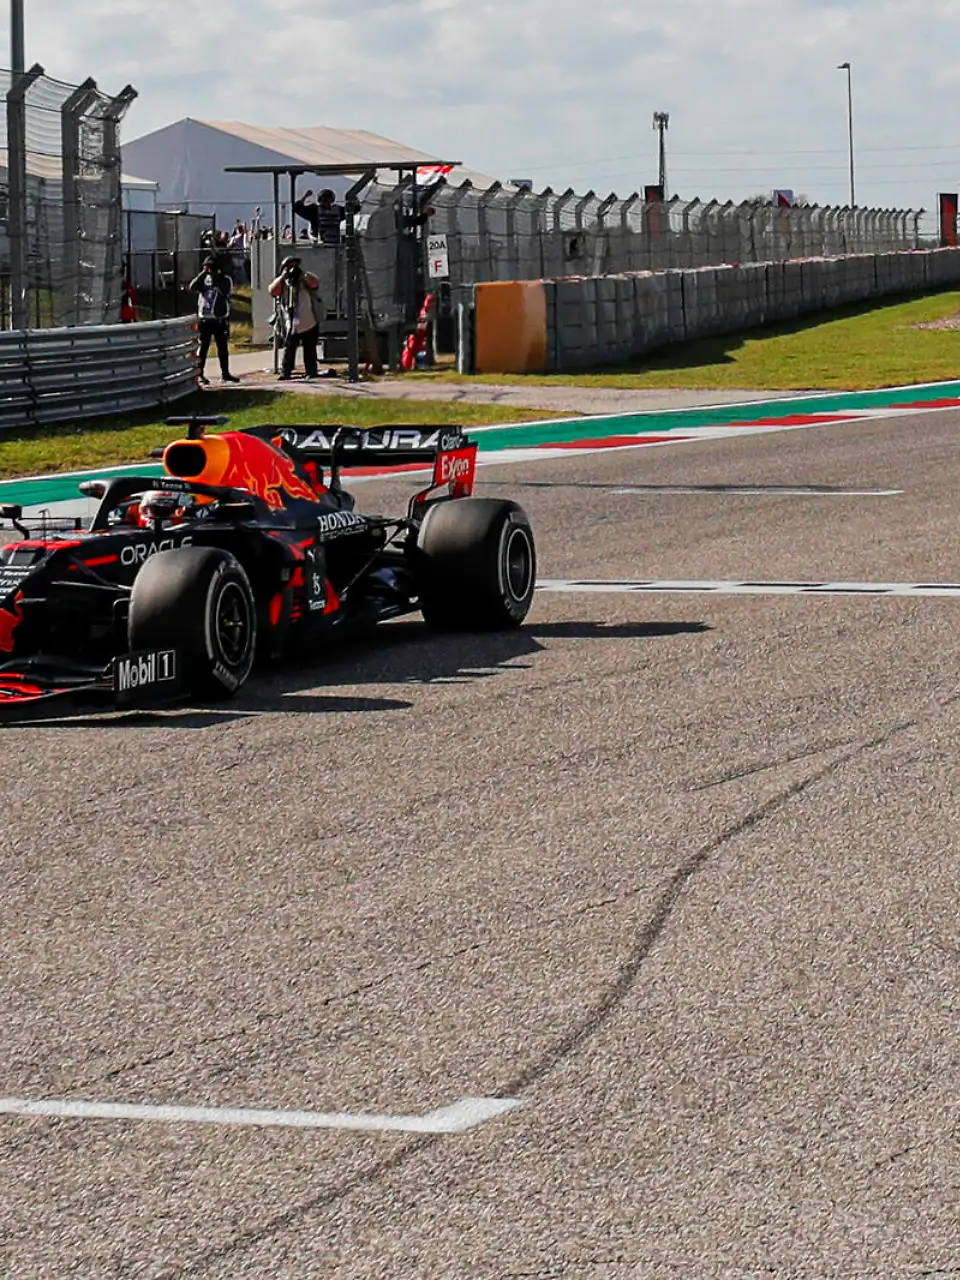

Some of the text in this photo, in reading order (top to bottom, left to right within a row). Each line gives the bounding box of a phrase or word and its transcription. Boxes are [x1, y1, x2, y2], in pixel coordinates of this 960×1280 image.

[430, 240, 447, 249] 20A
[434, 260, 442, 273] F
[317, 511, 366, 532] HONDA
[119, 653, 155, 691] Mobil
